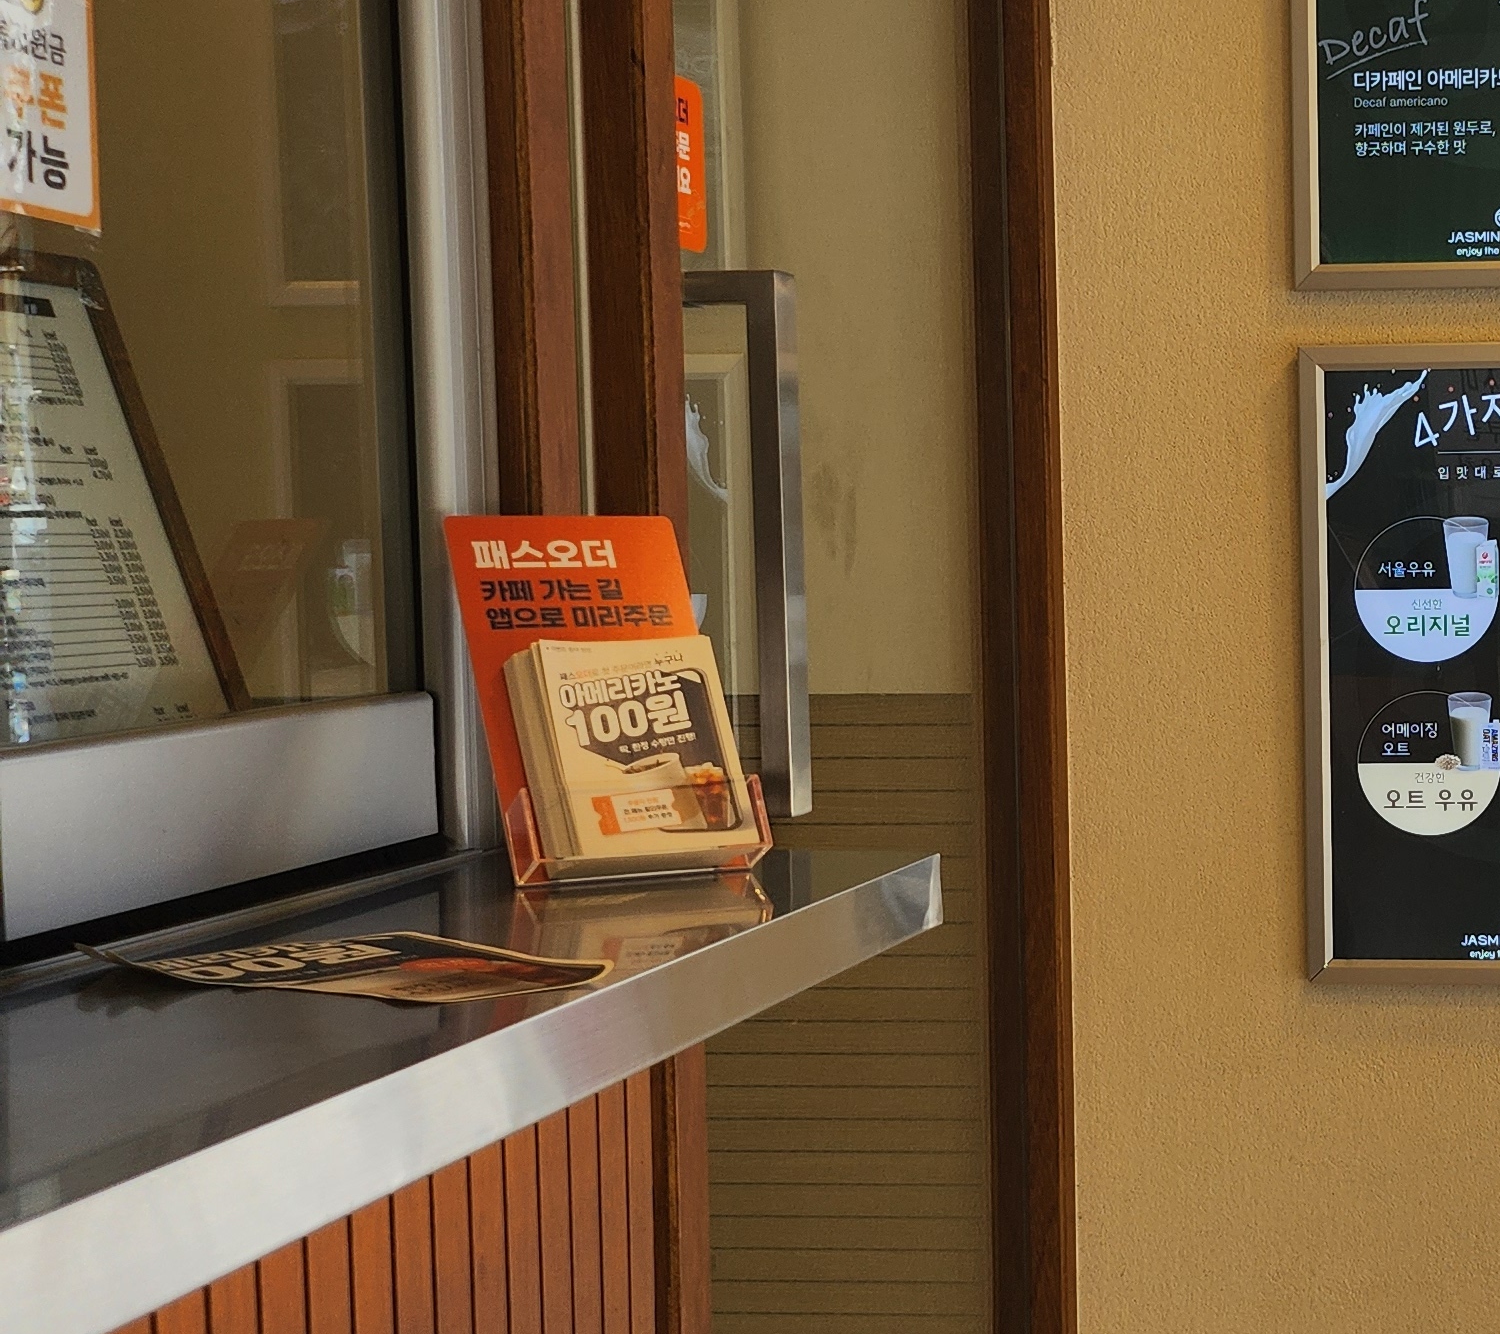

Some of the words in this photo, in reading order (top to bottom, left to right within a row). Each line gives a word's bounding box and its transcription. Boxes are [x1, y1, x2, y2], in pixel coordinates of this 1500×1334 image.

[1353, 69, 1422, 92] 디카페인
[1353, 96, 1386, 108] Decaf
[1389, 96, 1448, 107] americano
[1354, 122, 1406, 138] 카페인이
[1410, 121, 1449, 137] 제거된
[1453, 121, 1496, 137] 원두로,
[1354, 141, 1406, 157] 향긋하며
[1410, 140, 1449, 155] 구수한
[1453, 139, 1467, 155] 맛
[6, 129, 70, 189] 가능
[1448, 230, 1500, 243] JASMIN
[1456, 247, 1482, 257] enjoy
[1484, 245, 1499, 255] the
[471, 539, 618, 570] 패스오더
[1378, 561, 1436, 578] 서울우유
[480, 579, 534, 603] 카페
[540, 578, 592, 601] 가는
[597, 577, 624, 600] 길
[1411, 598, 1443, 611] 신선한
[485, 605, 567, 631] 앱으로
[572, 604, 674, 629] 미리주문
[1383, 614, 1471, 637] 오리지널
[559, 669, 682, 708] 아메리카노
[565, 689, 693, 747] 100원
[1381, 722, 1438, 739] 어메이징
[1381, 742, 1410, 757] 오트
[1384, 789, 1427, 810] 오트
[1435, 788, 1478, 811] 우유
